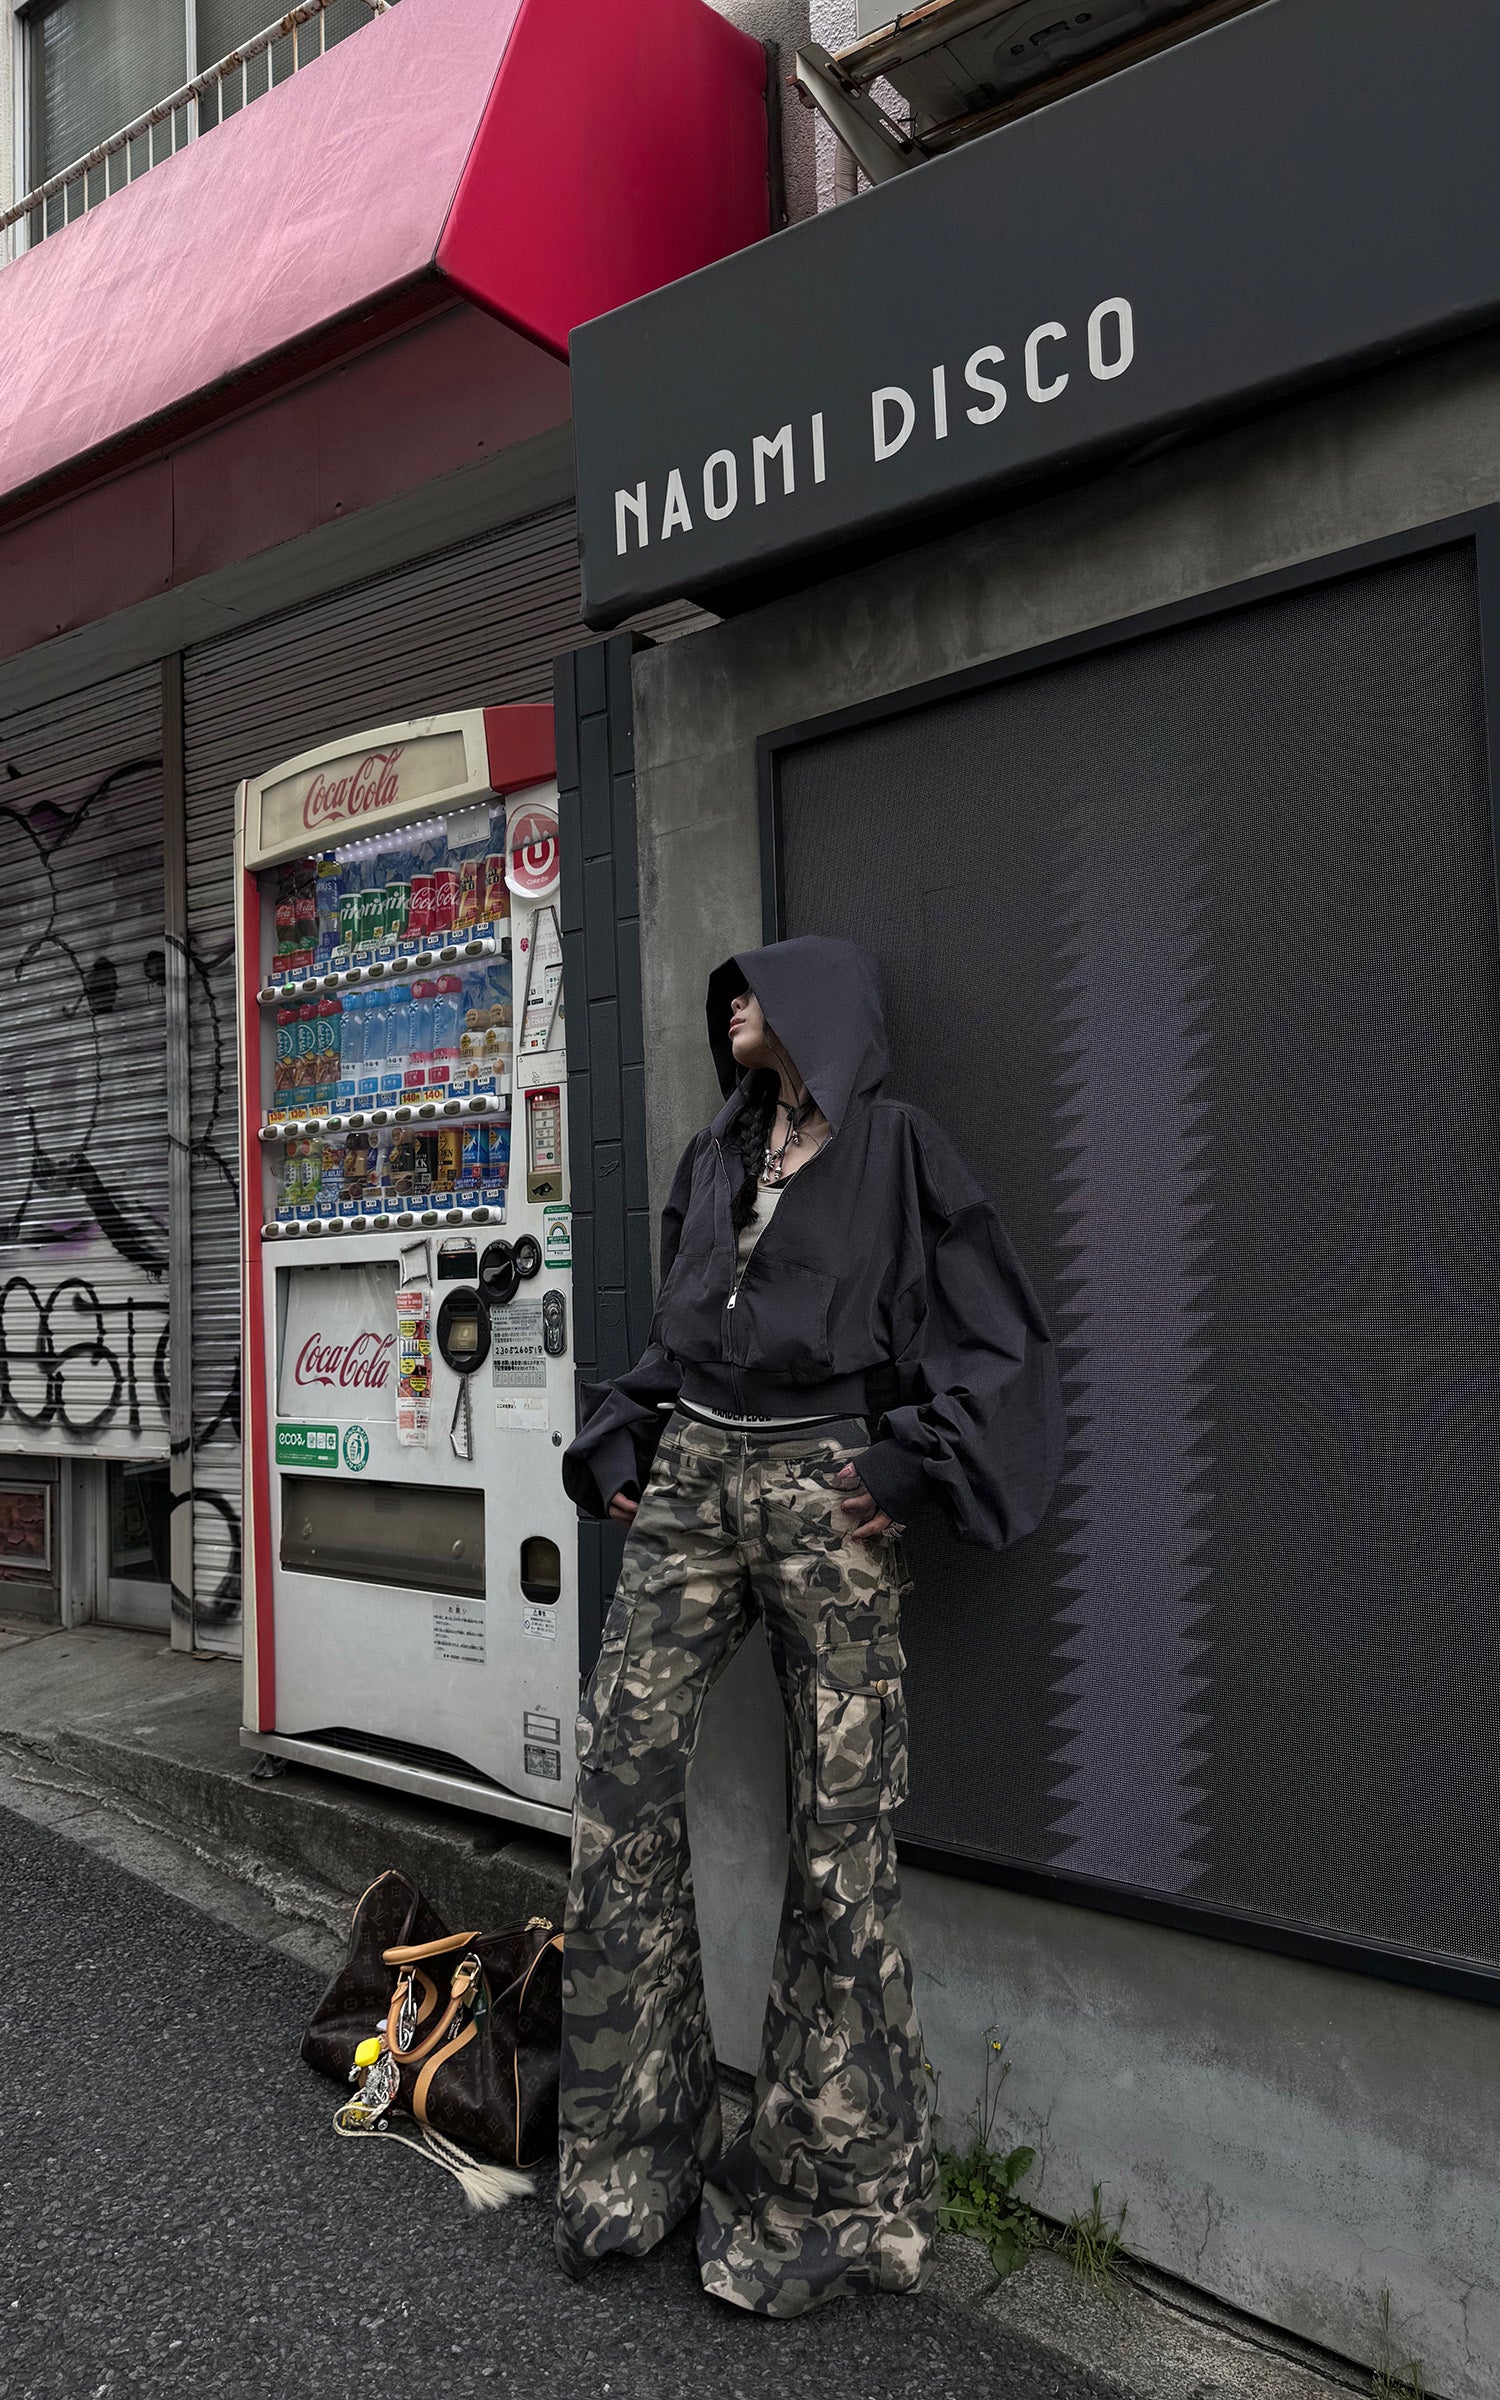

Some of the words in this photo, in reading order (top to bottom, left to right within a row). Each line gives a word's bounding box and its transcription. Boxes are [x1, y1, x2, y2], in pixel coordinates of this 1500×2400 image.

[614, 412, 826, 555] NAOMI
[871, 297, 1134, 462] DISCO
[303, 747, 405, 829] Coca-Cola
[295, 1332, 397, 1388] Coca-Cola
